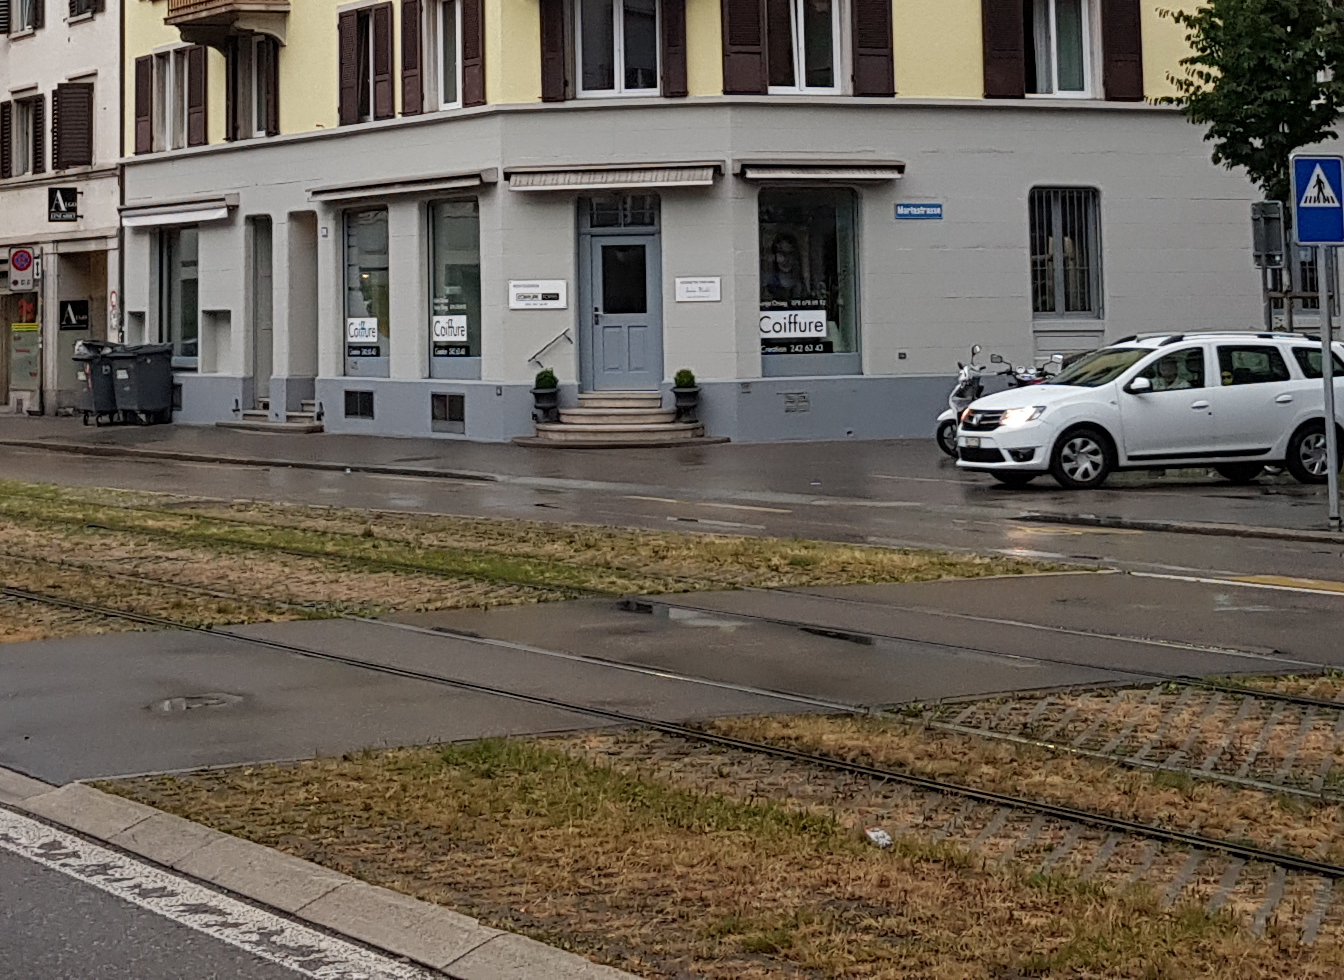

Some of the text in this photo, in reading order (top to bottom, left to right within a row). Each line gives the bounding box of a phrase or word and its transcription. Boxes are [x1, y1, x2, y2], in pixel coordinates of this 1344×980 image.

[348, 320, 376, 338] Coiffure
[434, 318, 465, 337] Coiffure
[760, 314, 824, 333] Coiffure
